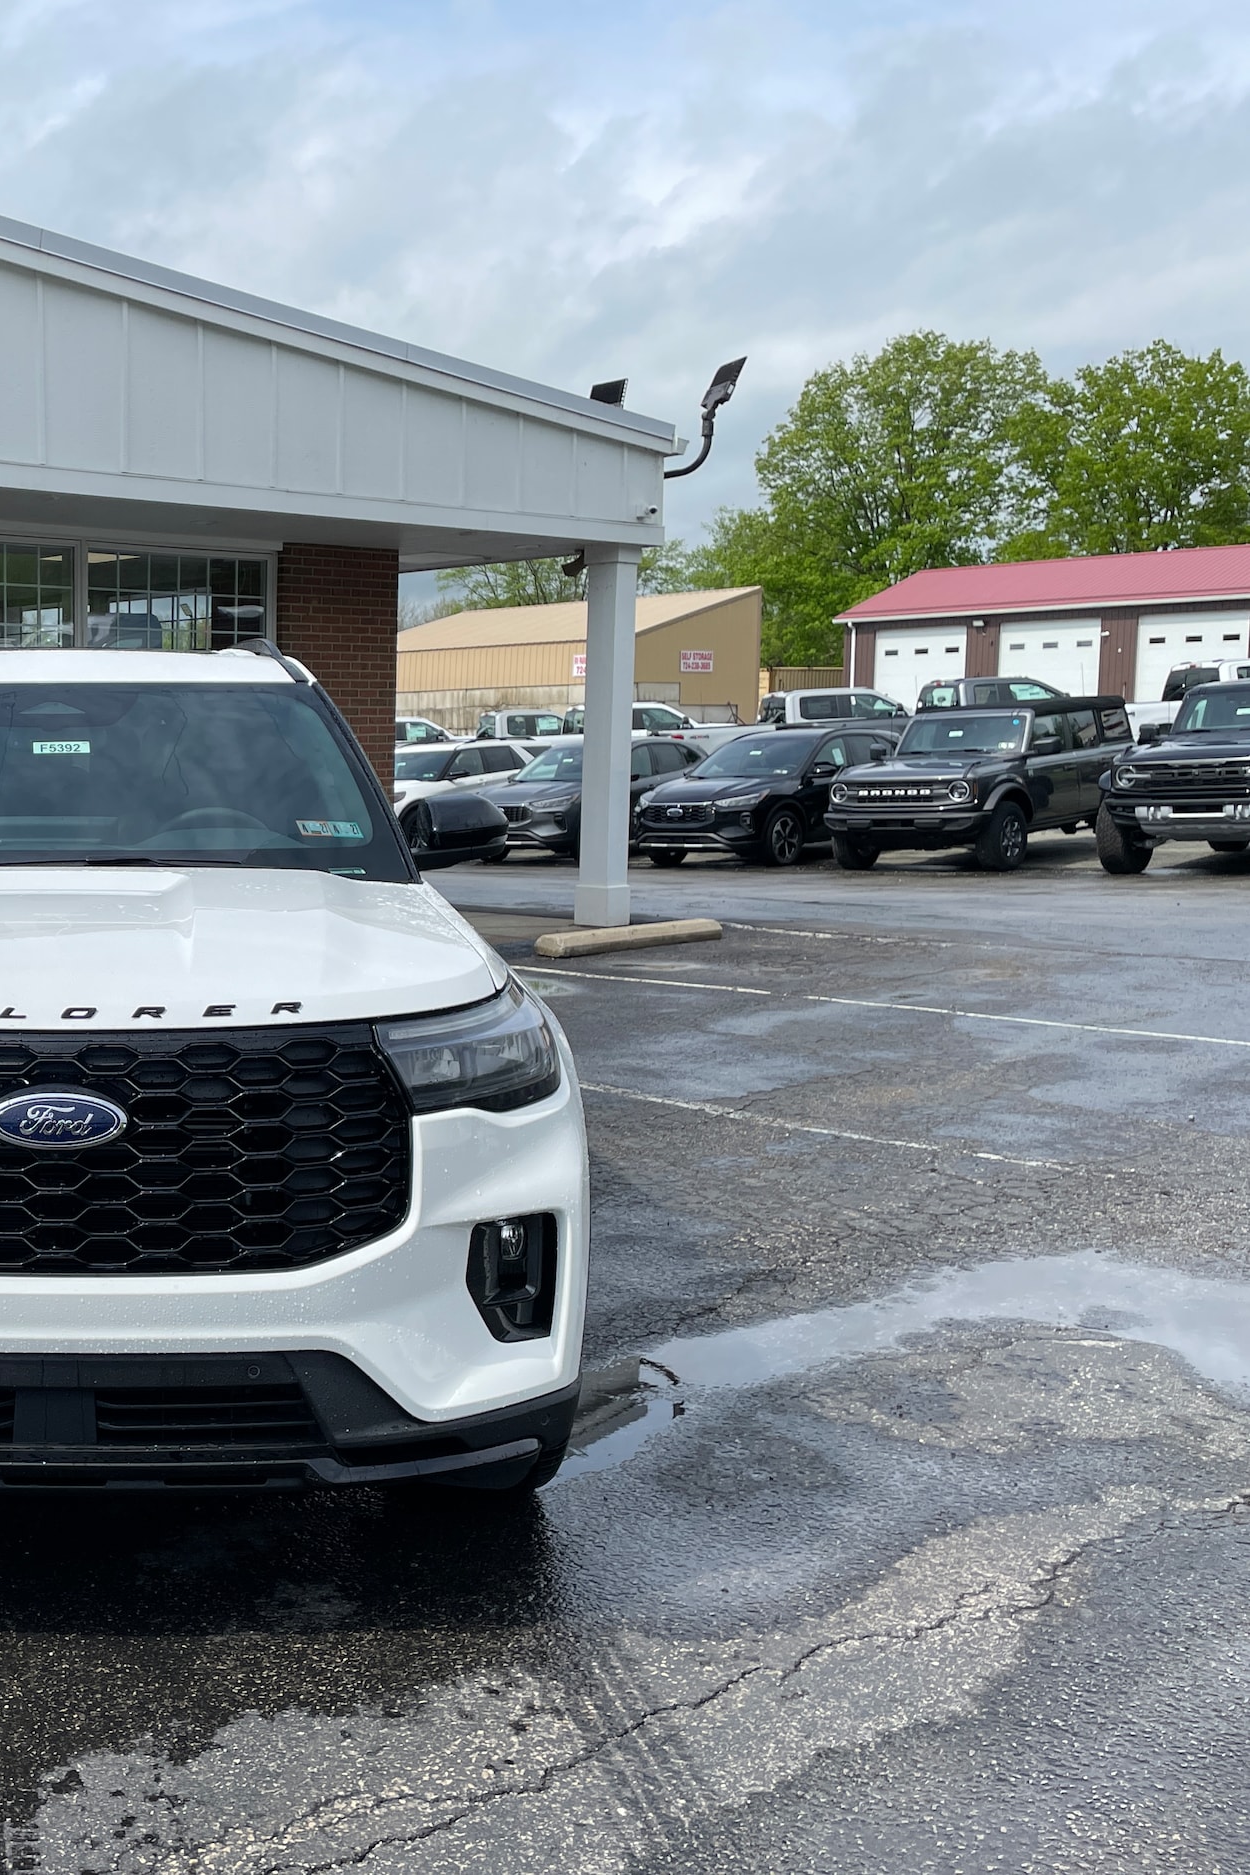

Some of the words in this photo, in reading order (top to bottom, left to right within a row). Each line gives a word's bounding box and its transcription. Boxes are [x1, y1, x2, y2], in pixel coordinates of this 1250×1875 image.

[693, 652, 713, 660] STORAGE
[39, 743, 82, 753] F5392
[18, 1104, 94, 1137] Ford
